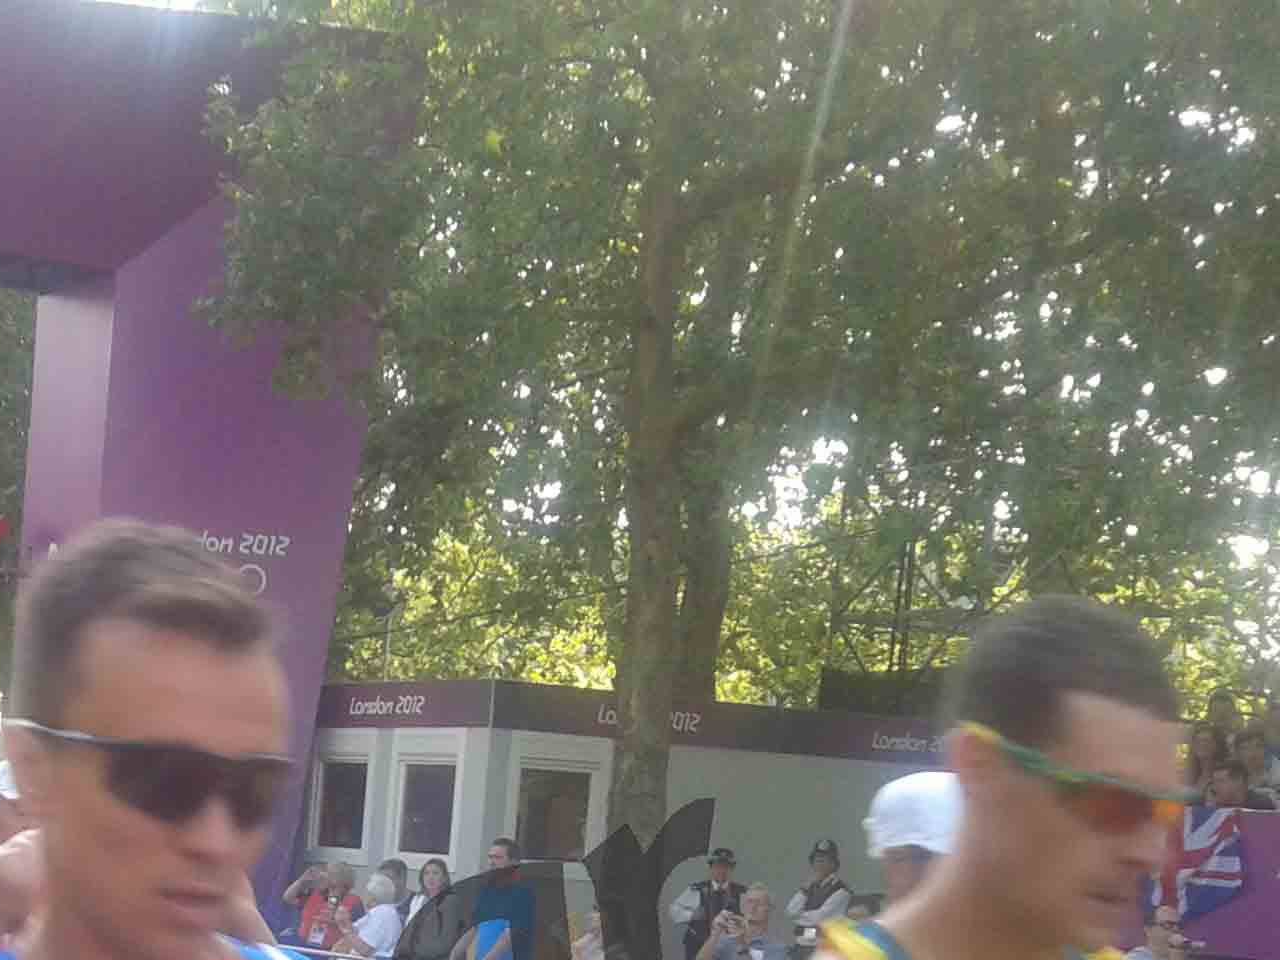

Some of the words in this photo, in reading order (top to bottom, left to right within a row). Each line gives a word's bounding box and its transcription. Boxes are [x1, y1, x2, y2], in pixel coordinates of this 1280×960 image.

[238, 532, 291, 556] 2012
[349, 696, 393, 715] London
[394, 695, 425, 714] 2012
[668, 711, 702, 733] 012
